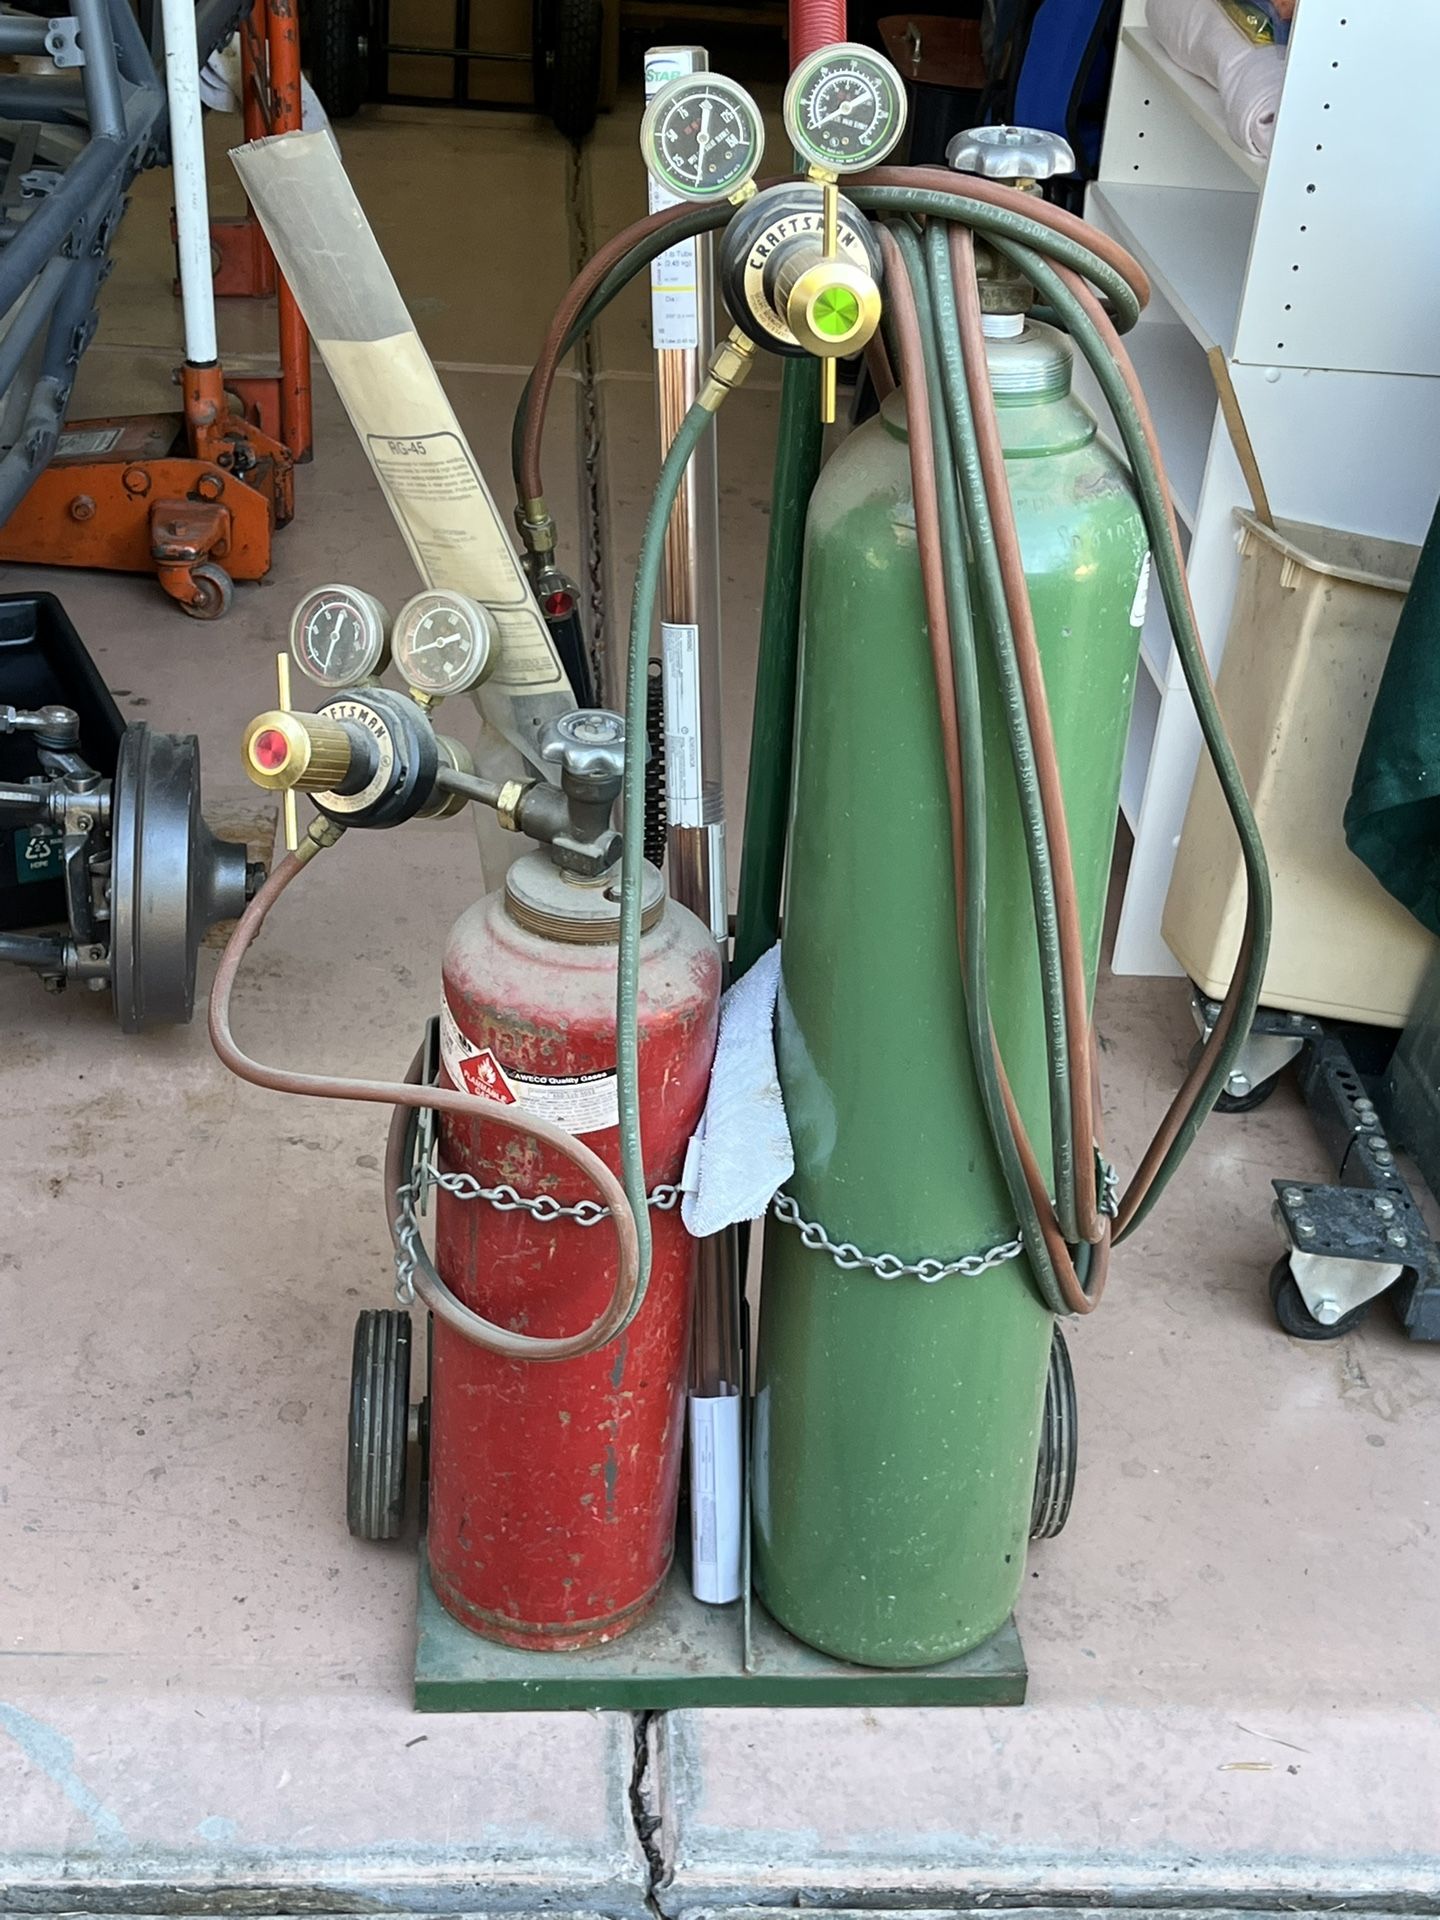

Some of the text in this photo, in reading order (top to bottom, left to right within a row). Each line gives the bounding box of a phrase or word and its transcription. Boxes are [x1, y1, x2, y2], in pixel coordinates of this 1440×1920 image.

[387, 440, 427, 456] RG-45
[322, 706, 386, 738] FTSMAN
[514, 1071, 608, 1085] AWECO Quality Gases
